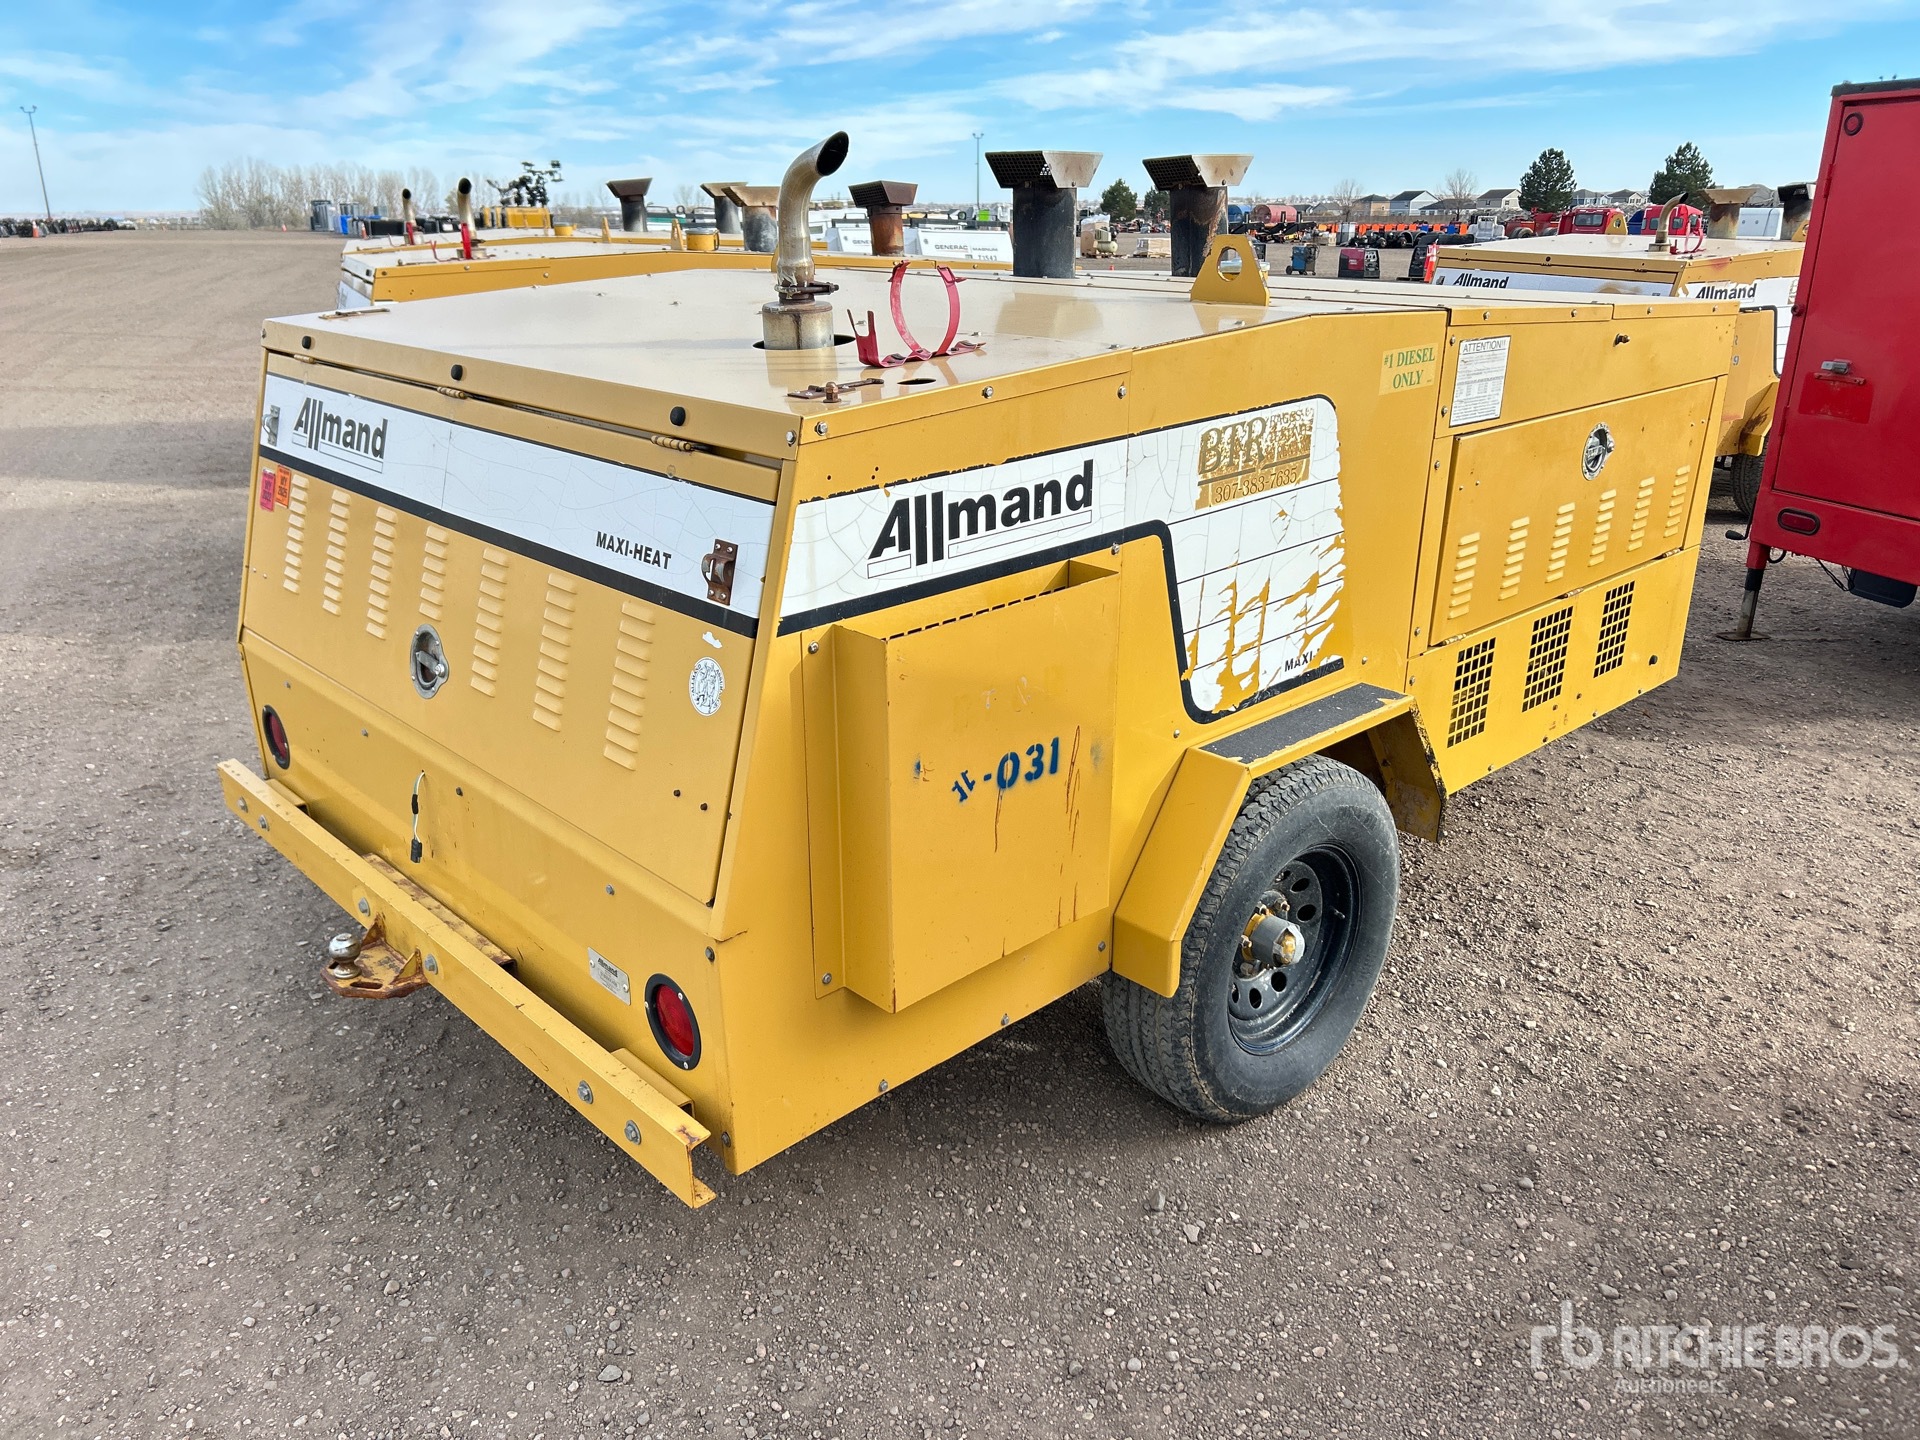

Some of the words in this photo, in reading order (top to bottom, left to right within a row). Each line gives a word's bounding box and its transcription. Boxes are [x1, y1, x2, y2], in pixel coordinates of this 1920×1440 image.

[1453, 273, 1509, 289] Allmand
[1696, 282, 1757, 301] Allmand
[1397, 347, 1436, 368] DIESEL
[1392, 369, 1424, 389] ONLY
[293, 397, 389, 460] Allmand
[1198, 416, 1265, 475] BTR
[1215, 466, 1298, 504] 307-383-7635
[868, 459, 1094, 566] Allmand
[596, 531, 672, 570] MAXI-HEAT
